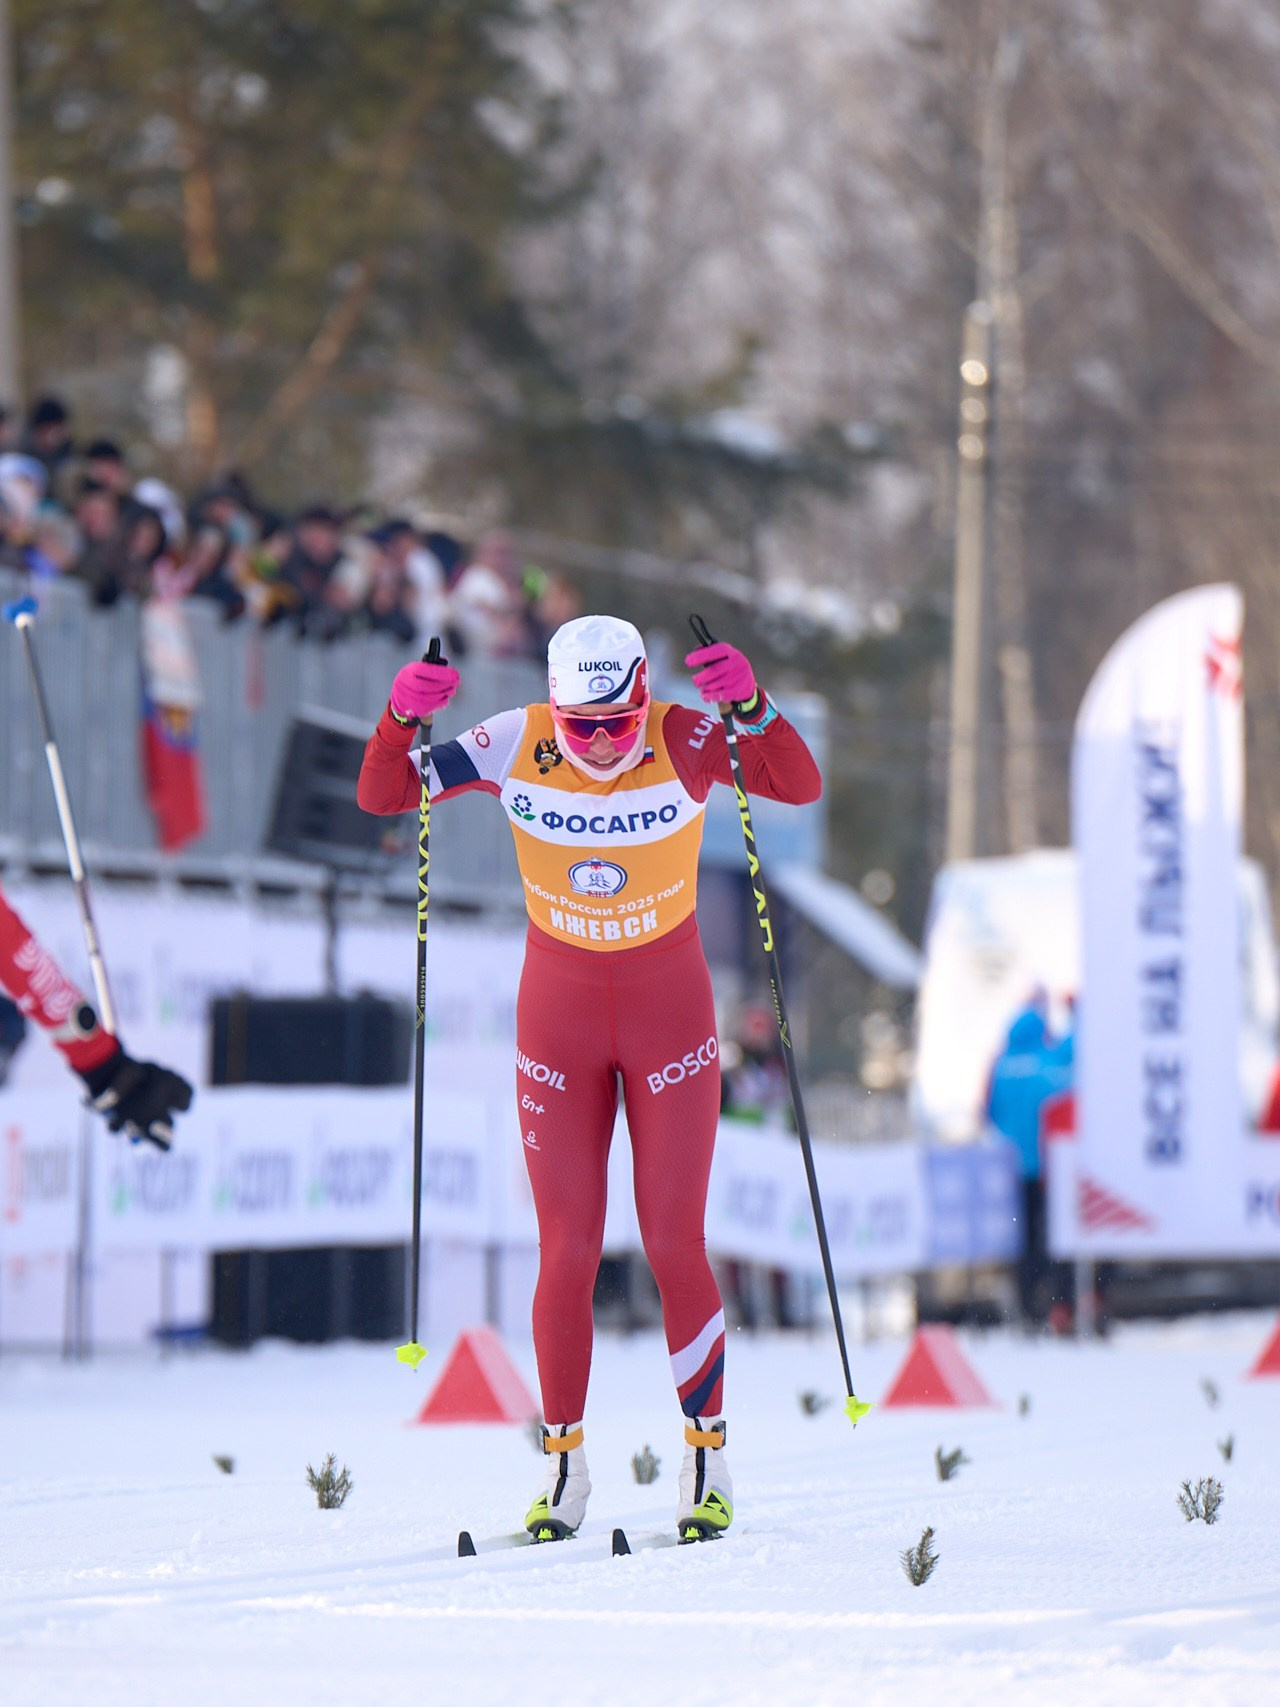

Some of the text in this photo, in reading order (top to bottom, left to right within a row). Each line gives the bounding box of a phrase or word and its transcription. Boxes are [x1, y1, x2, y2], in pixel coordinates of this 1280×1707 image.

[578, 661, 623, 672] LUKOIL
[541, 804, 678, 834] ФОСАГРО
[559, 895, 613, 916] России
[617, 894, 655, 915] 2025
[657, 879, 685, 903] года
[549, 907, 658, 941] ИЖЕВСК
[647, 1035, 718, 1095] BOSCO
